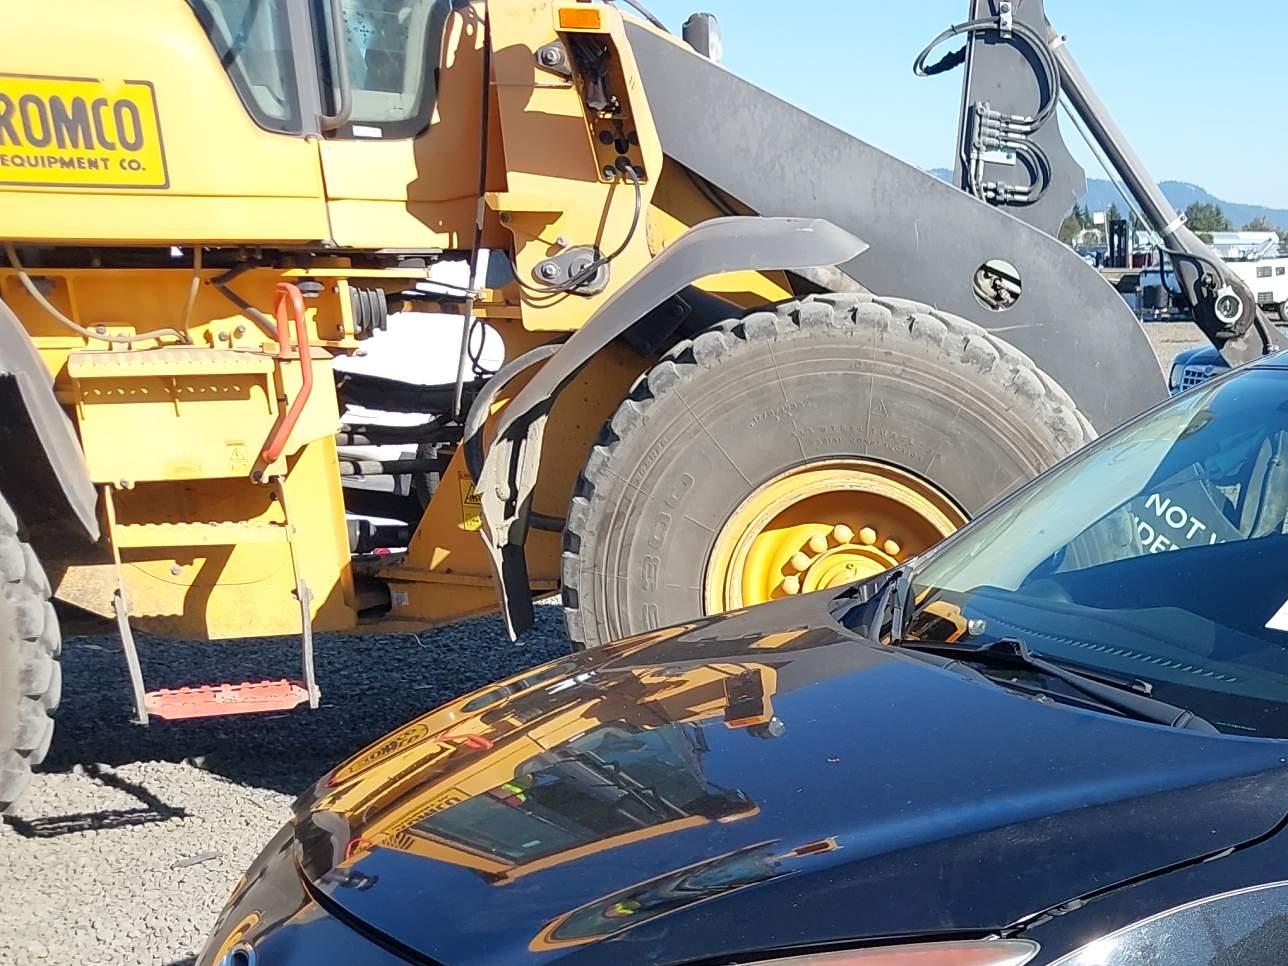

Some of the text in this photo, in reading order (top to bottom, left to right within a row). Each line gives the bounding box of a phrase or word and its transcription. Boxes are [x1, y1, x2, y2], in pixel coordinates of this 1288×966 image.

[1, 154, 147, 172] EQUIPMENT CO.
[1144, 493, 1206, 539] NOT
